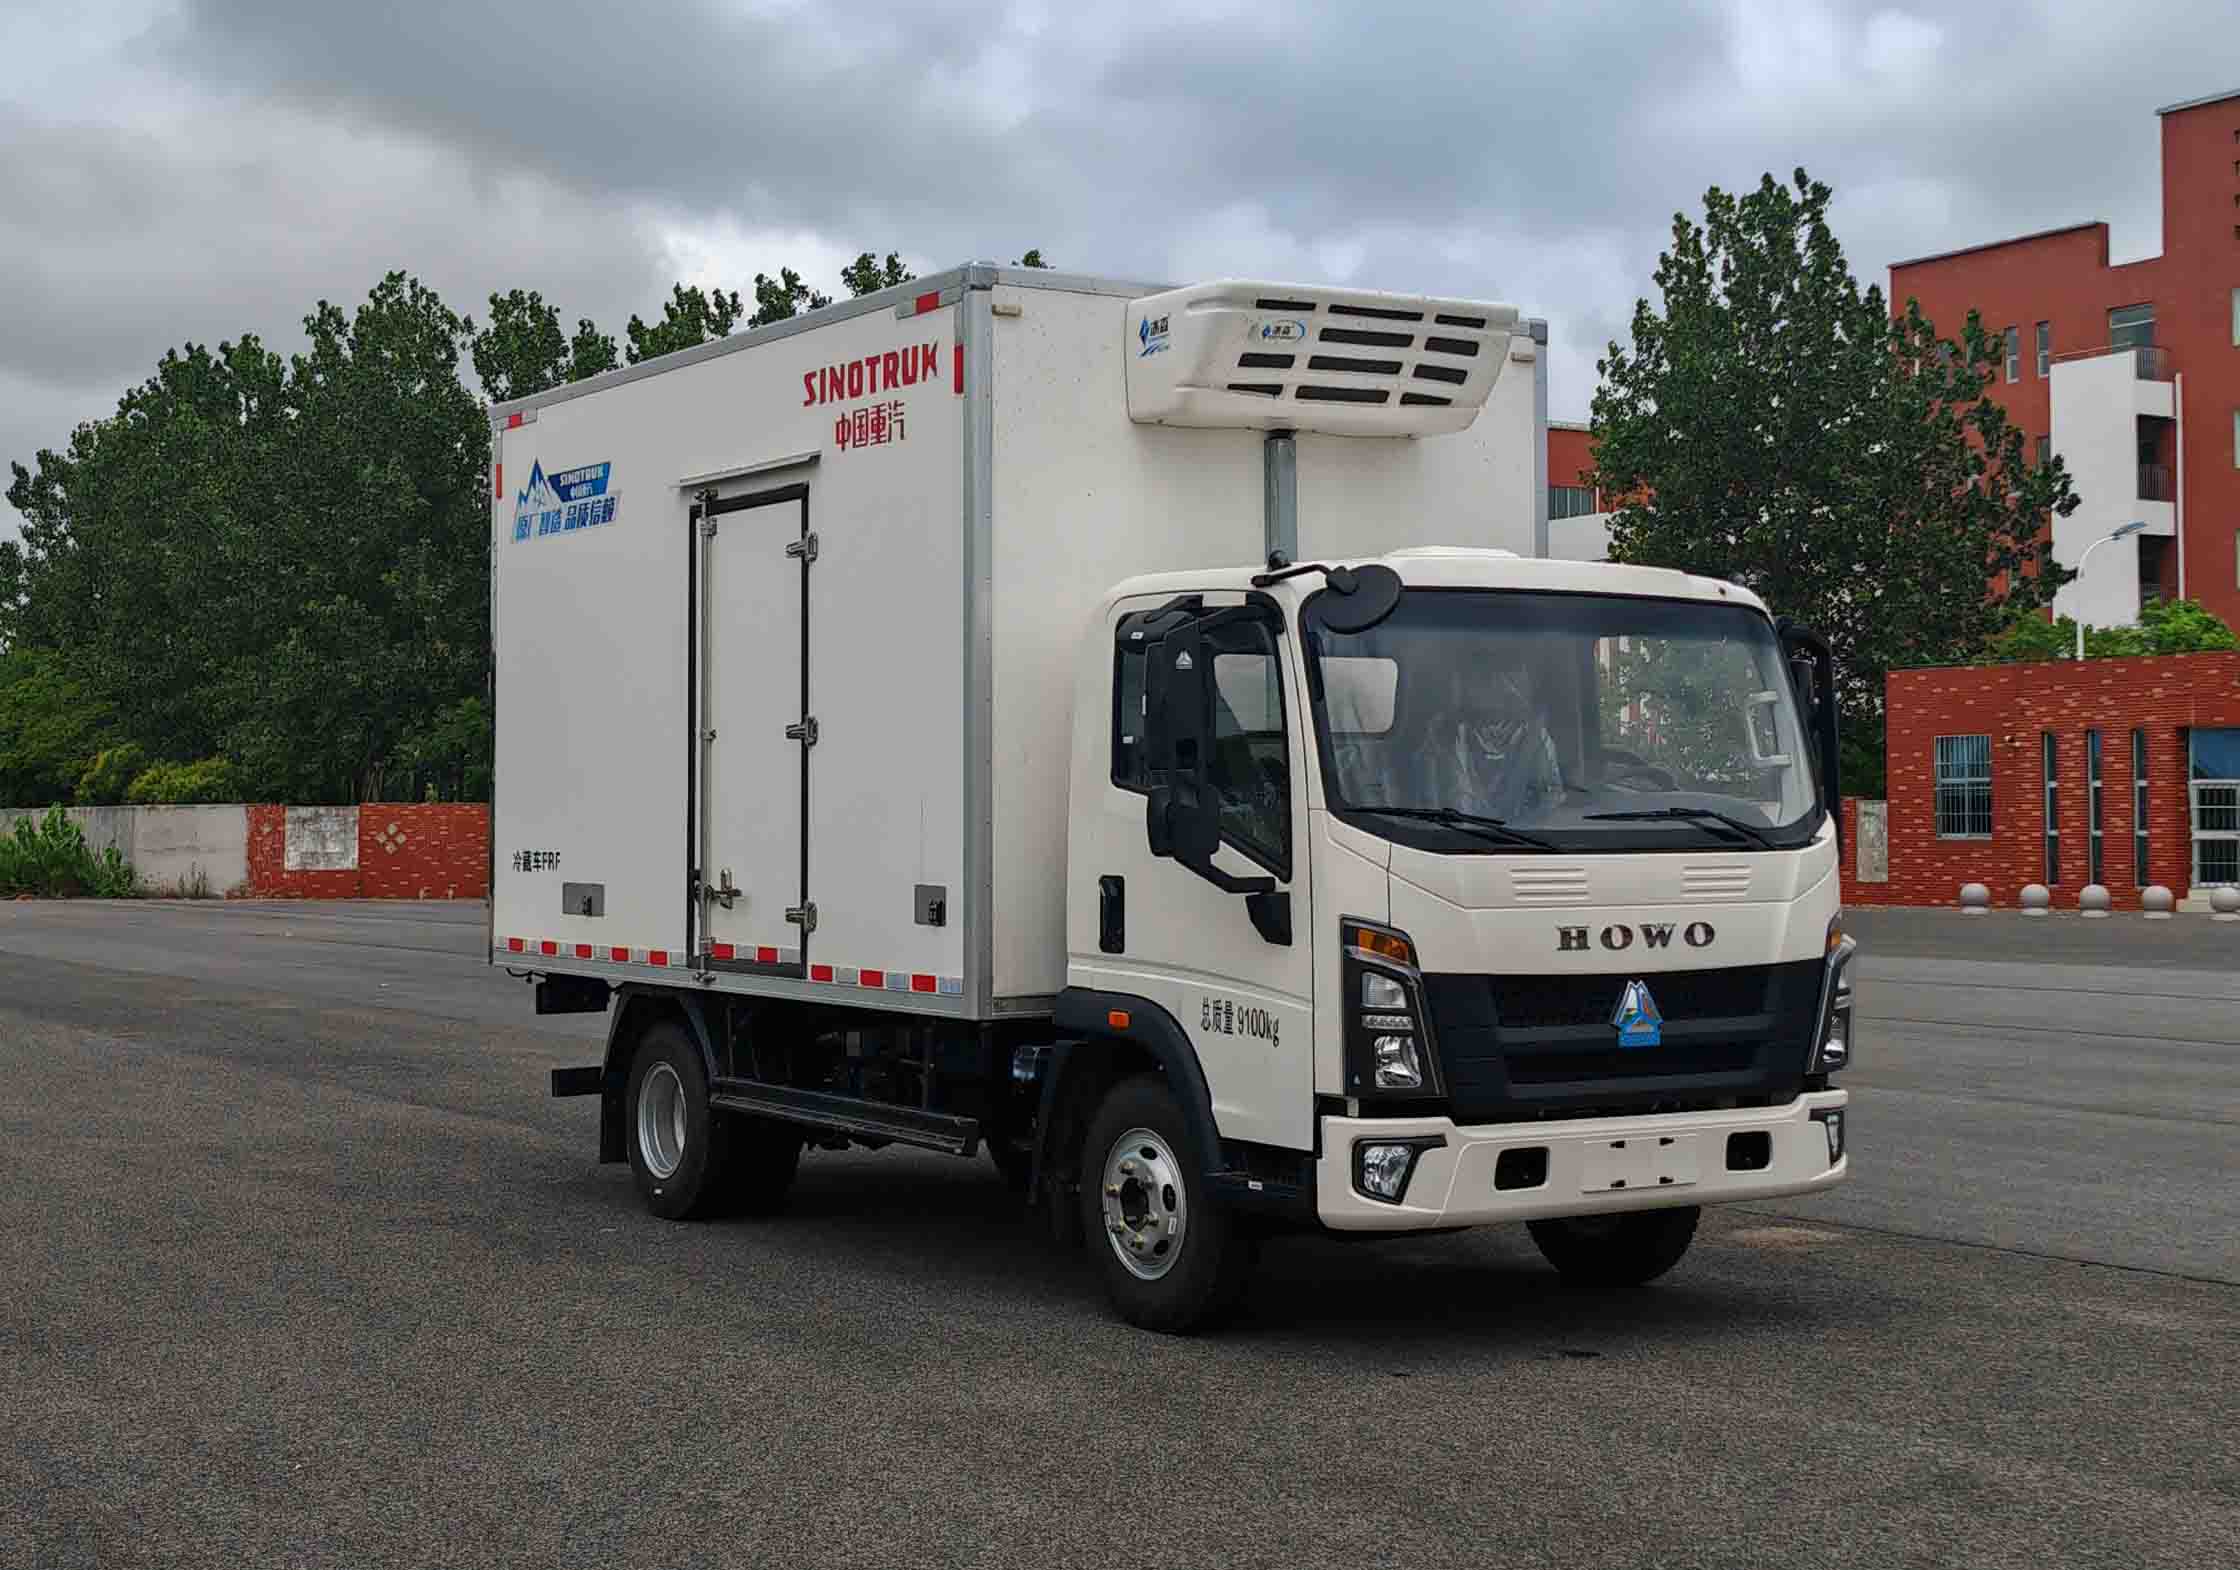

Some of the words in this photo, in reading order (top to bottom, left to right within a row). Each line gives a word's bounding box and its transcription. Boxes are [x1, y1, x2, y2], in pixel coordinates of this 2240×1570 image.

[803, 341, 937, 407] SINOTRUK
[835, 400, 906, 452] 中国重汽
[560, 466, 605, 487] SINOTRUK
[1556, 921, 1715, 951] HOWO
